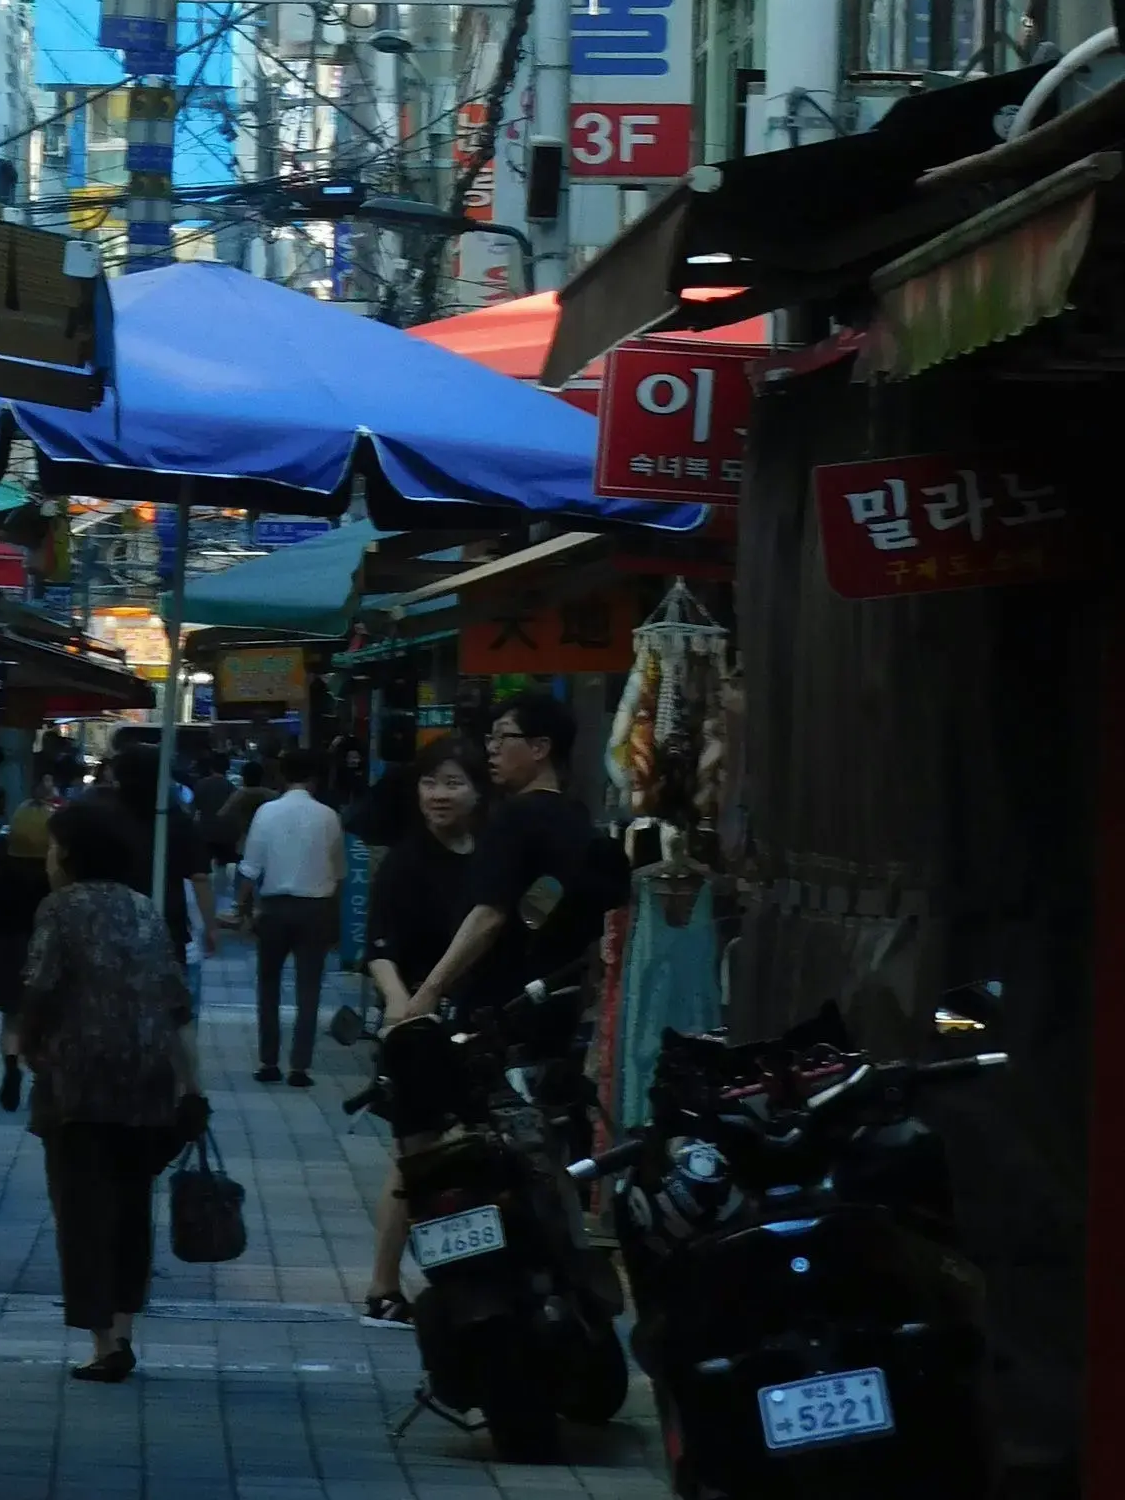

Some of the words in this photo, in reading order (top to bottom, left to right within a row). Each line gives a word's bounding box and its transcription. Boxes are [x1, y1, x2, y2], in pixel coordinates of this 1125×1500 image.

[572, 112, 660, 165] 3F
[629, 453, 711, 481] 숙녀복
[842, 469, 1068, 552] 밀라노
[439, 1225, 496, 1255] 4688
[796, 1393, 877, 1433] 5221
